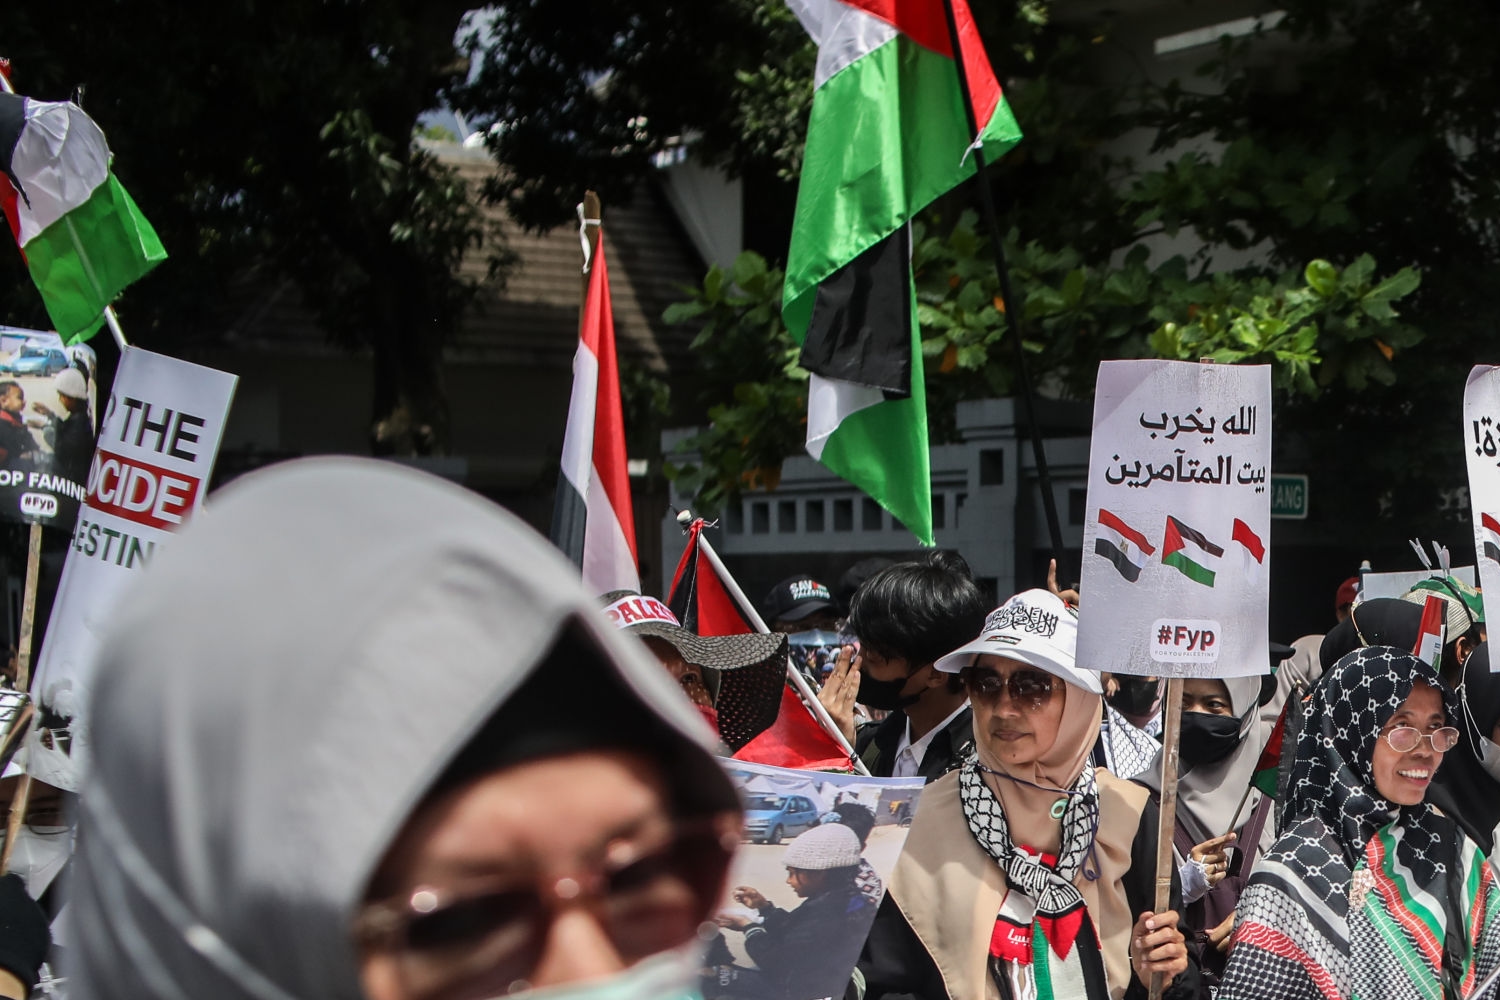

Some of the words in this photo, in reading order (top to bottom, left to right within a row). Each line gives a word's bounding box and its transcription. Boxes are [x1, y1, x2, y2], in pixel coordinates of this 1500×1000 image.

[120, 397, 206, 463] THE
[1139, 406, 1216, 444] يخرب
[1222, 405, 1257, 436] الله
[0, 470, 24, 486] OP
[1105, 448, 1232, 489] المتآمرين
[1236, 462, 1266, 494] بيت
[25, 496, 55, 511] #Fyp
[88, 451, 191, 525] OCIDE
[1157, 625, 1216, 651] #Fyp
